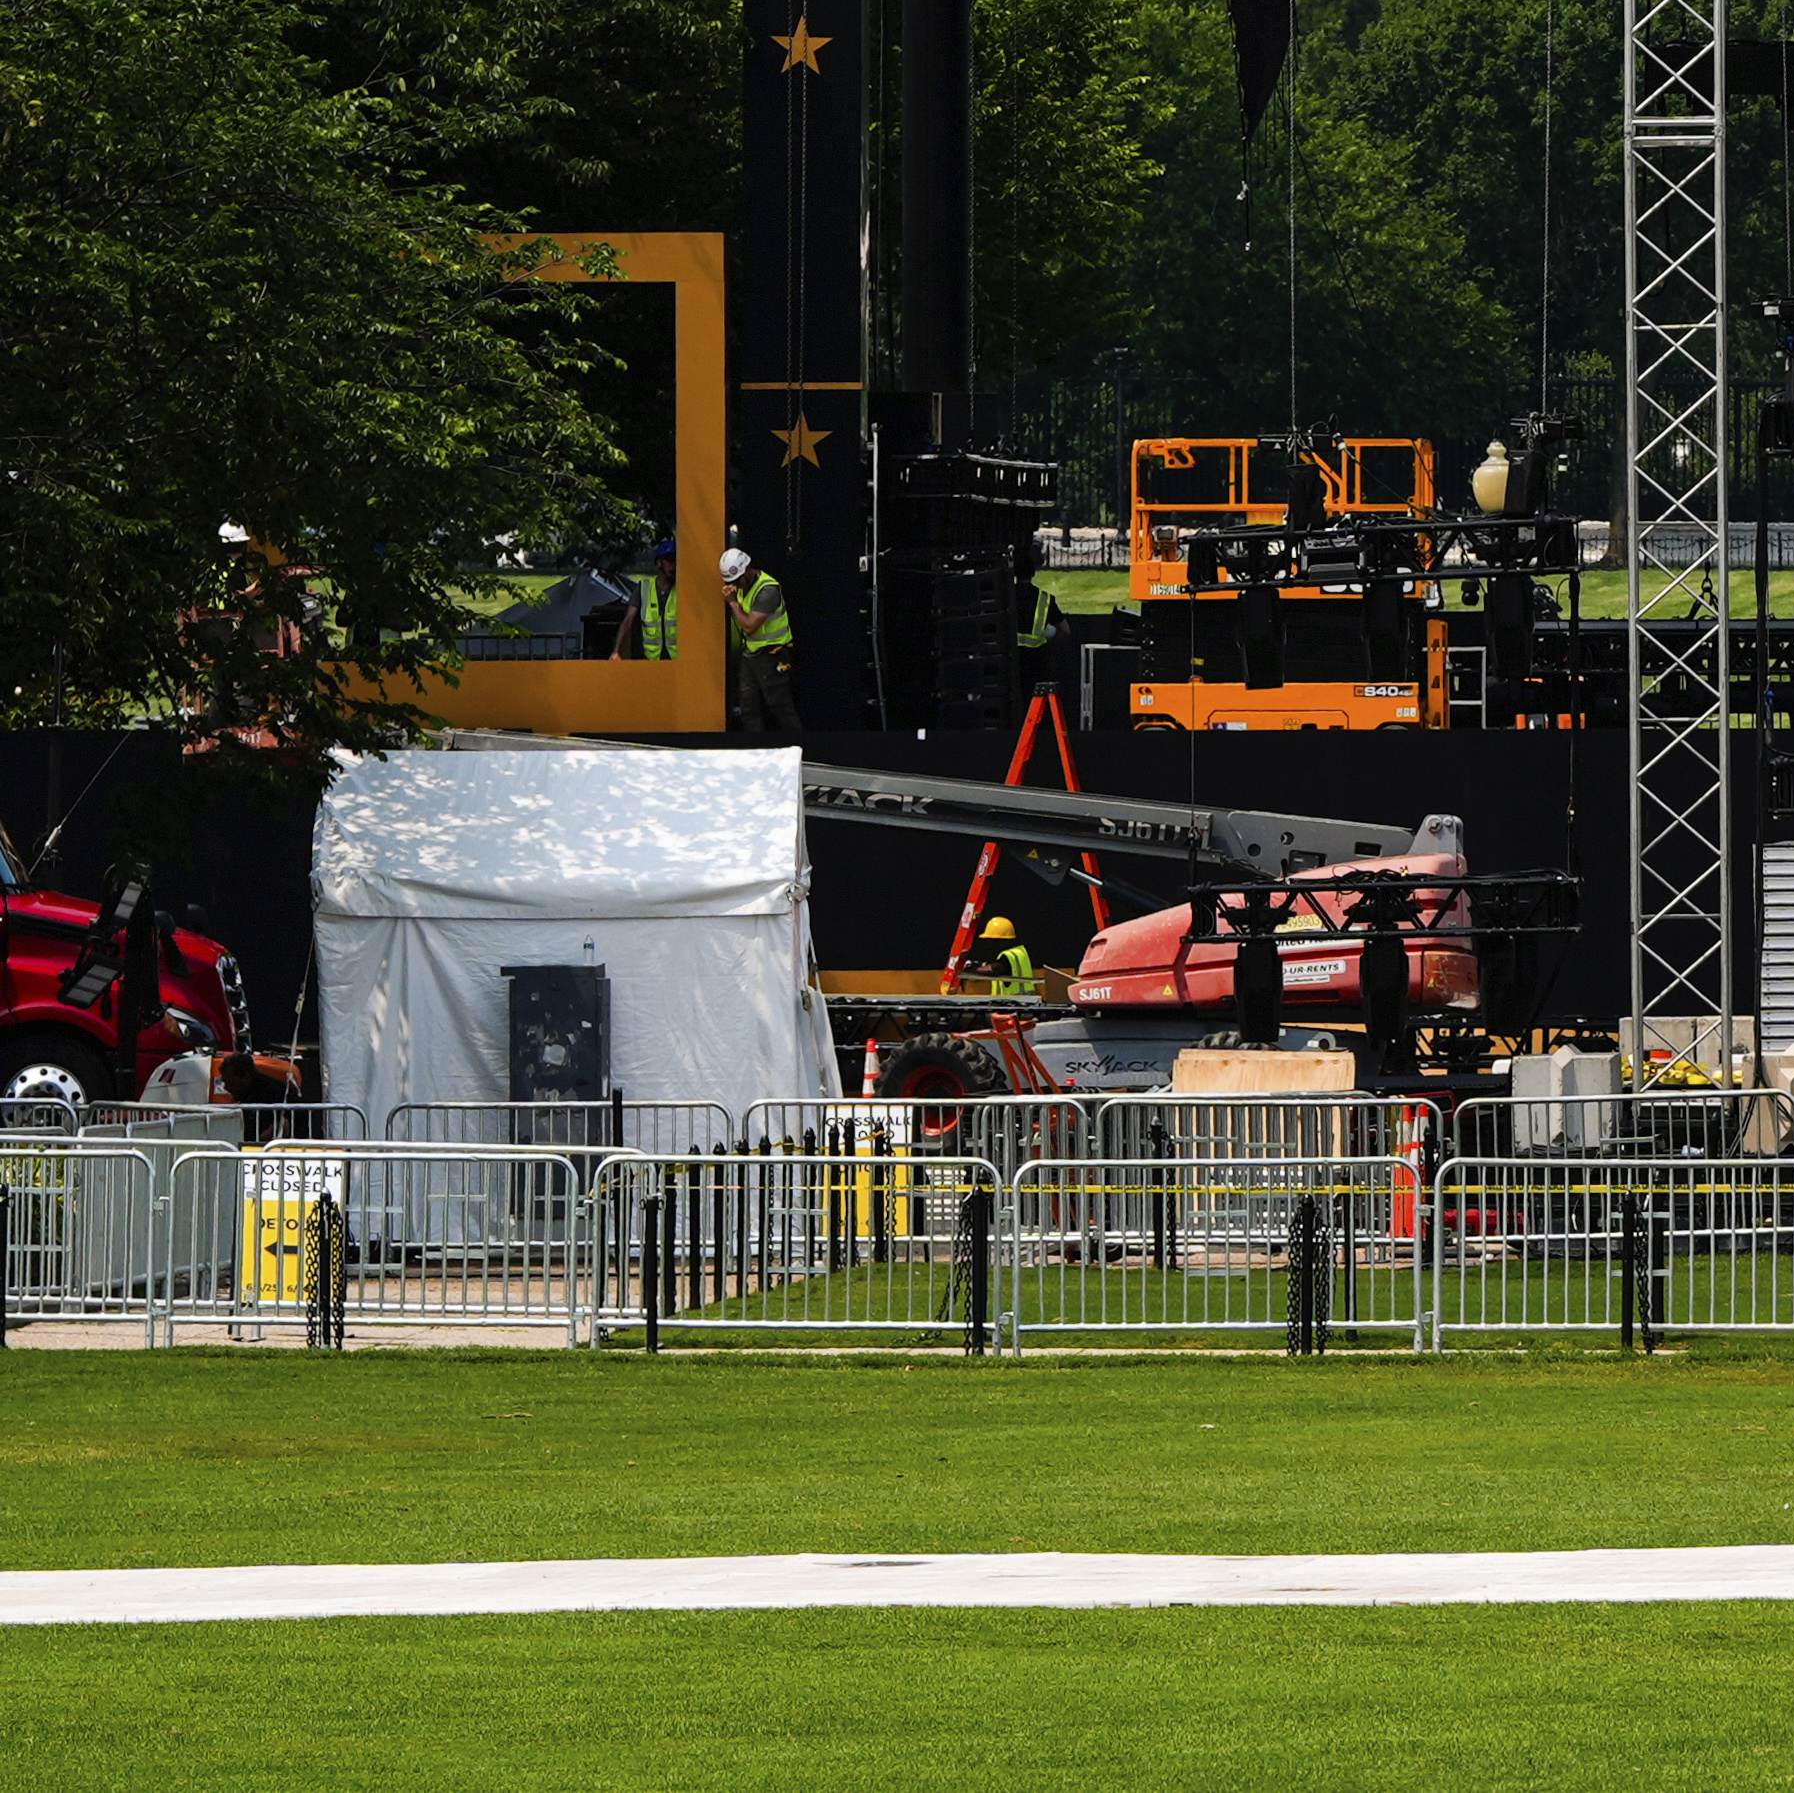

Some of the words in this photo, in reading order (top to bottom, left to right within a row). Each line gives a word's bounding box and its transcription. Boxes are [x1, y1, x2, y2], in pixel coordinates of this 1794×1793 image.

[1079, 986, 1113, 1002] SJ61T
[1064, 1054, 1158, 1076] SKYJACK
[825, 1116, 912, 1127] CRSSWALK
